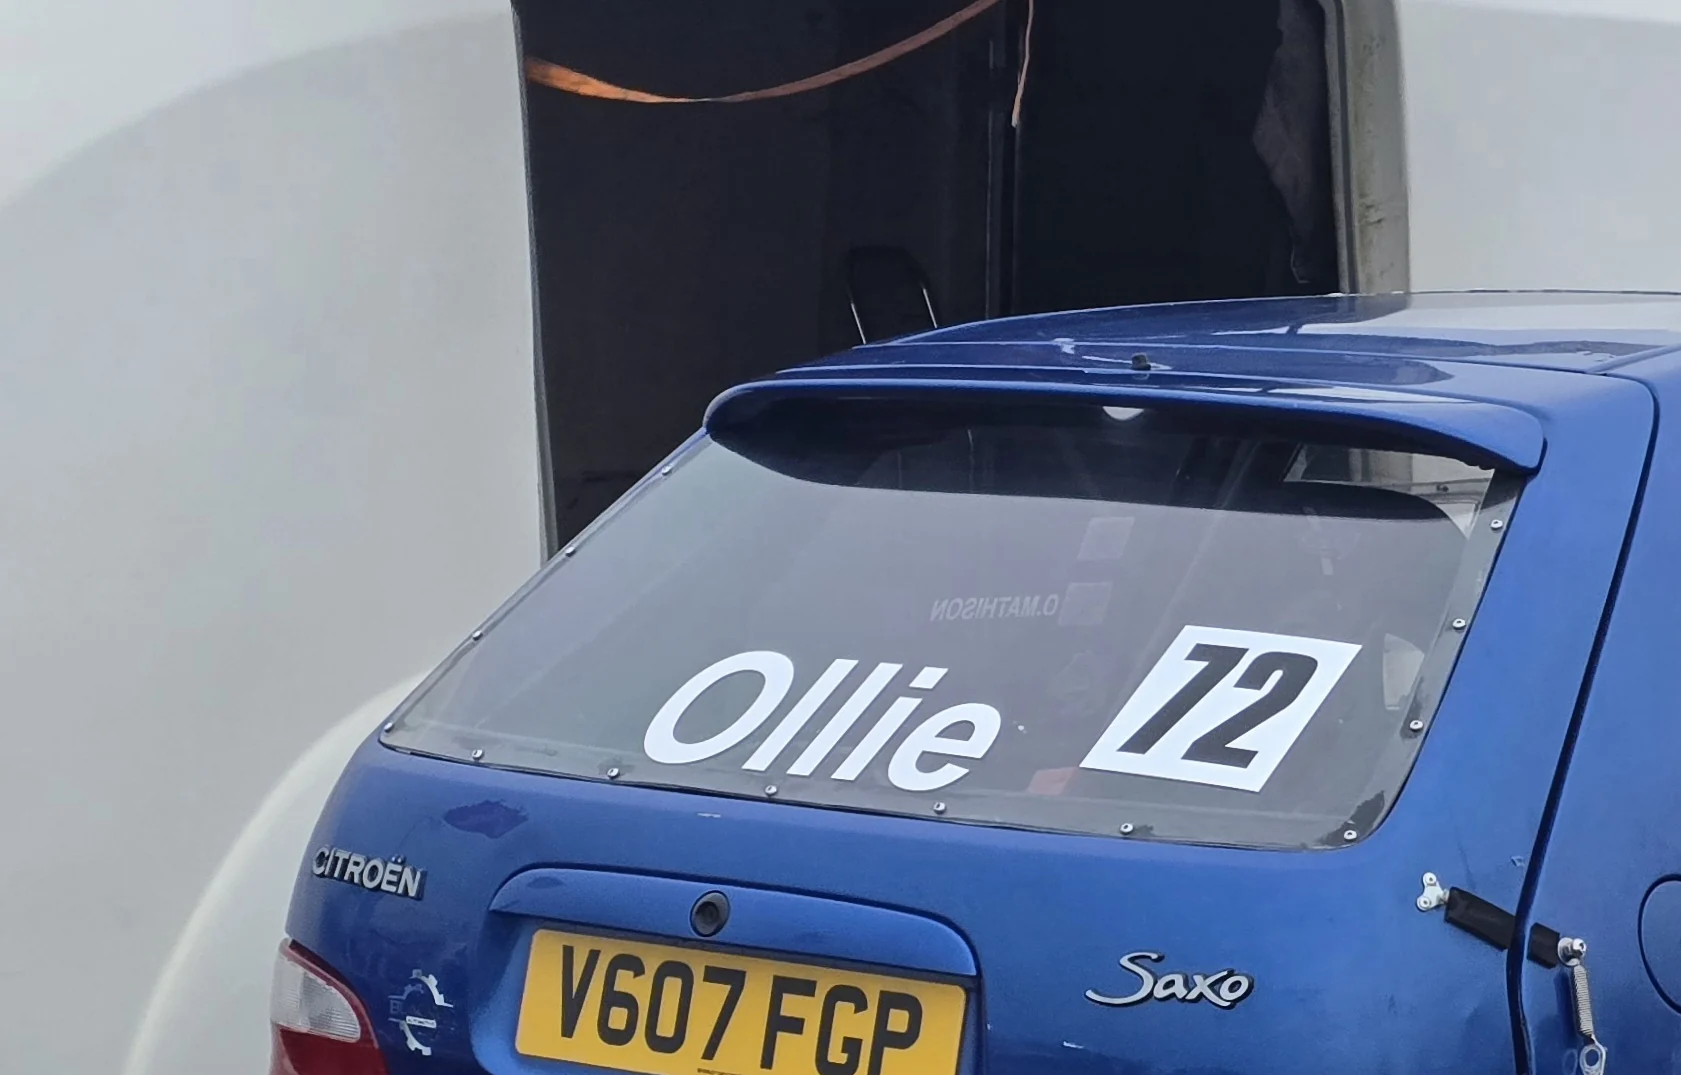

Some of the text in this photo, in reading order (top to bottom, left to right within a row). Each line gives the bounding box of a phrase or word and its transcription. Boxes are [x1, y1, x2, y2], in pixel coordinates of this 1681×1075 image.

[644, 650, 1001, 791] Ollie
[1116, 643, 1318, 768] 72
[312, 846, 426, 900] CITROËN
[561, 944, 747, 1061] V607
[1085, 952, 1254, 1009] Saxo
